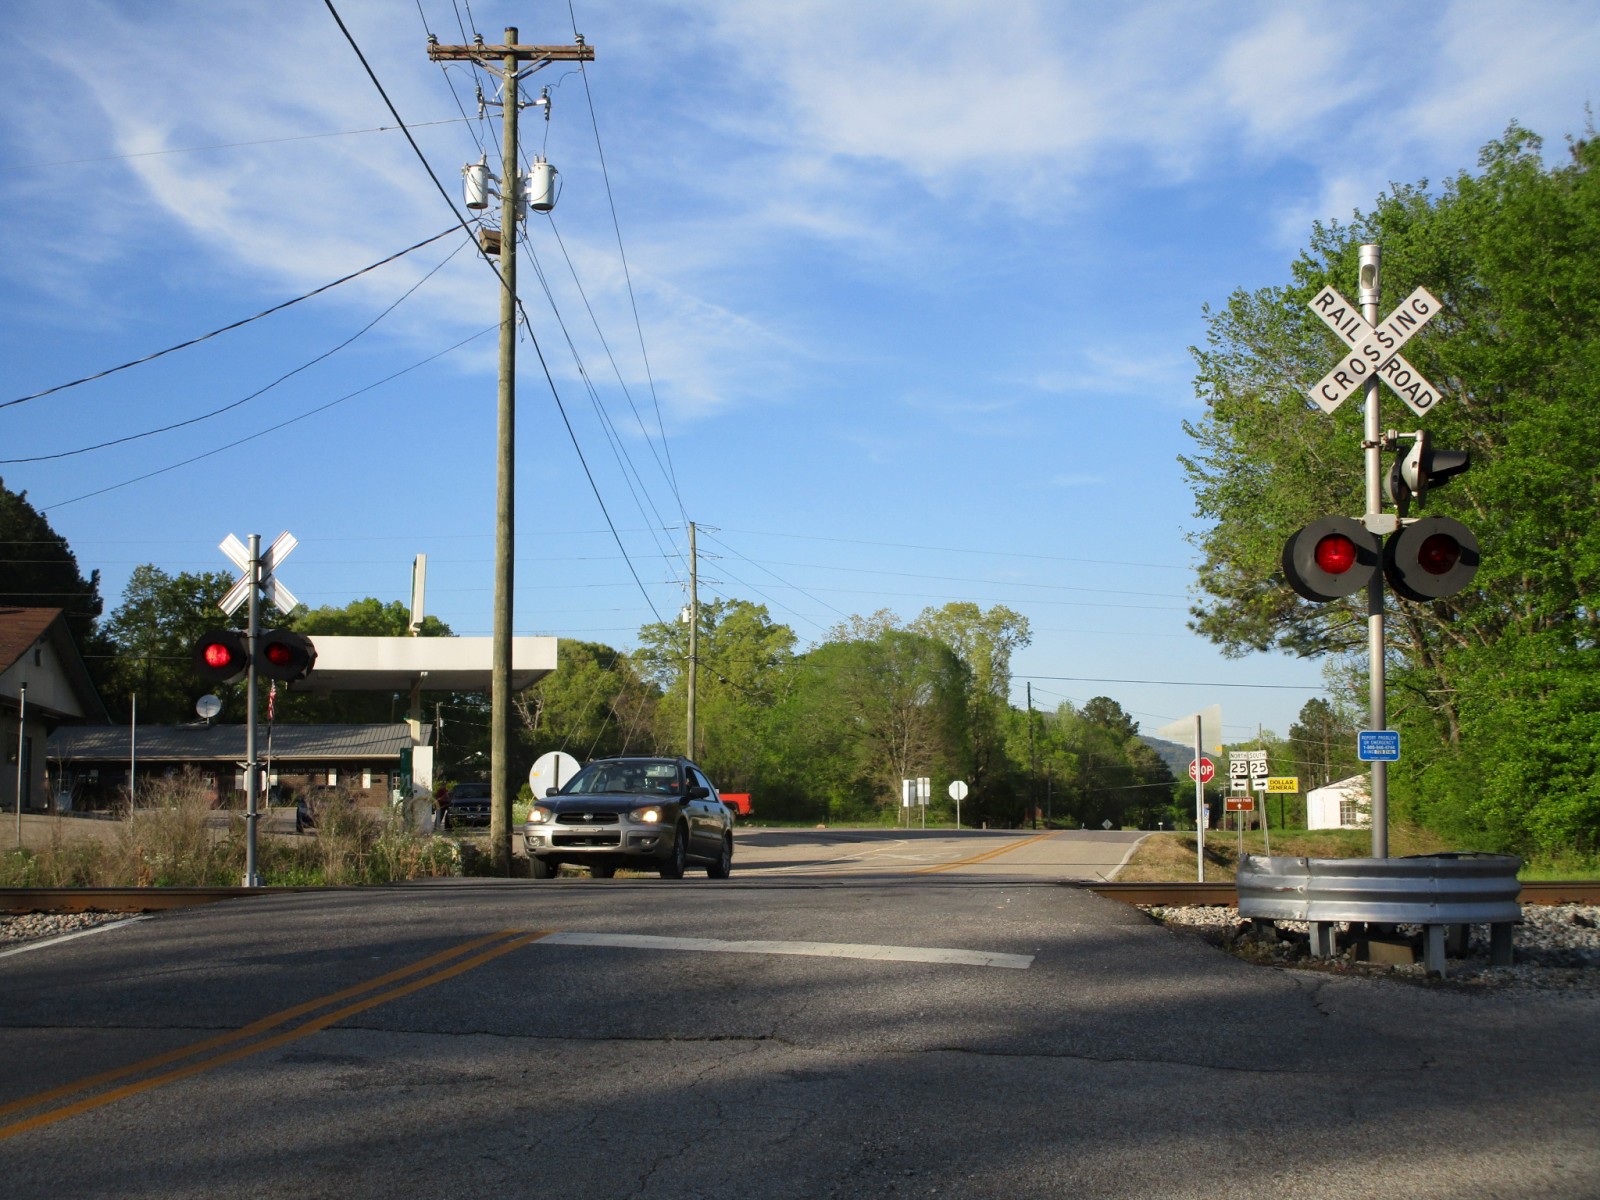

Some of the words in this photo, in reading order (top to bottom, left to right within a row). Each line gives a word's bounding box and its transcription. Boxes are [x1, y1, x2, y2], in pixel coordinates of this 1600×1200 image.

[1315, 292, 1361, 342] RAIL
[1382, 358, 1432, 409] ROAD
[1321, 298, 1429, 402] CROSSING
[1190, 765, 1213, 776] SOP
[1231, 763, 1247, 773] 25
[1251, 762, 1267, 773] 25
